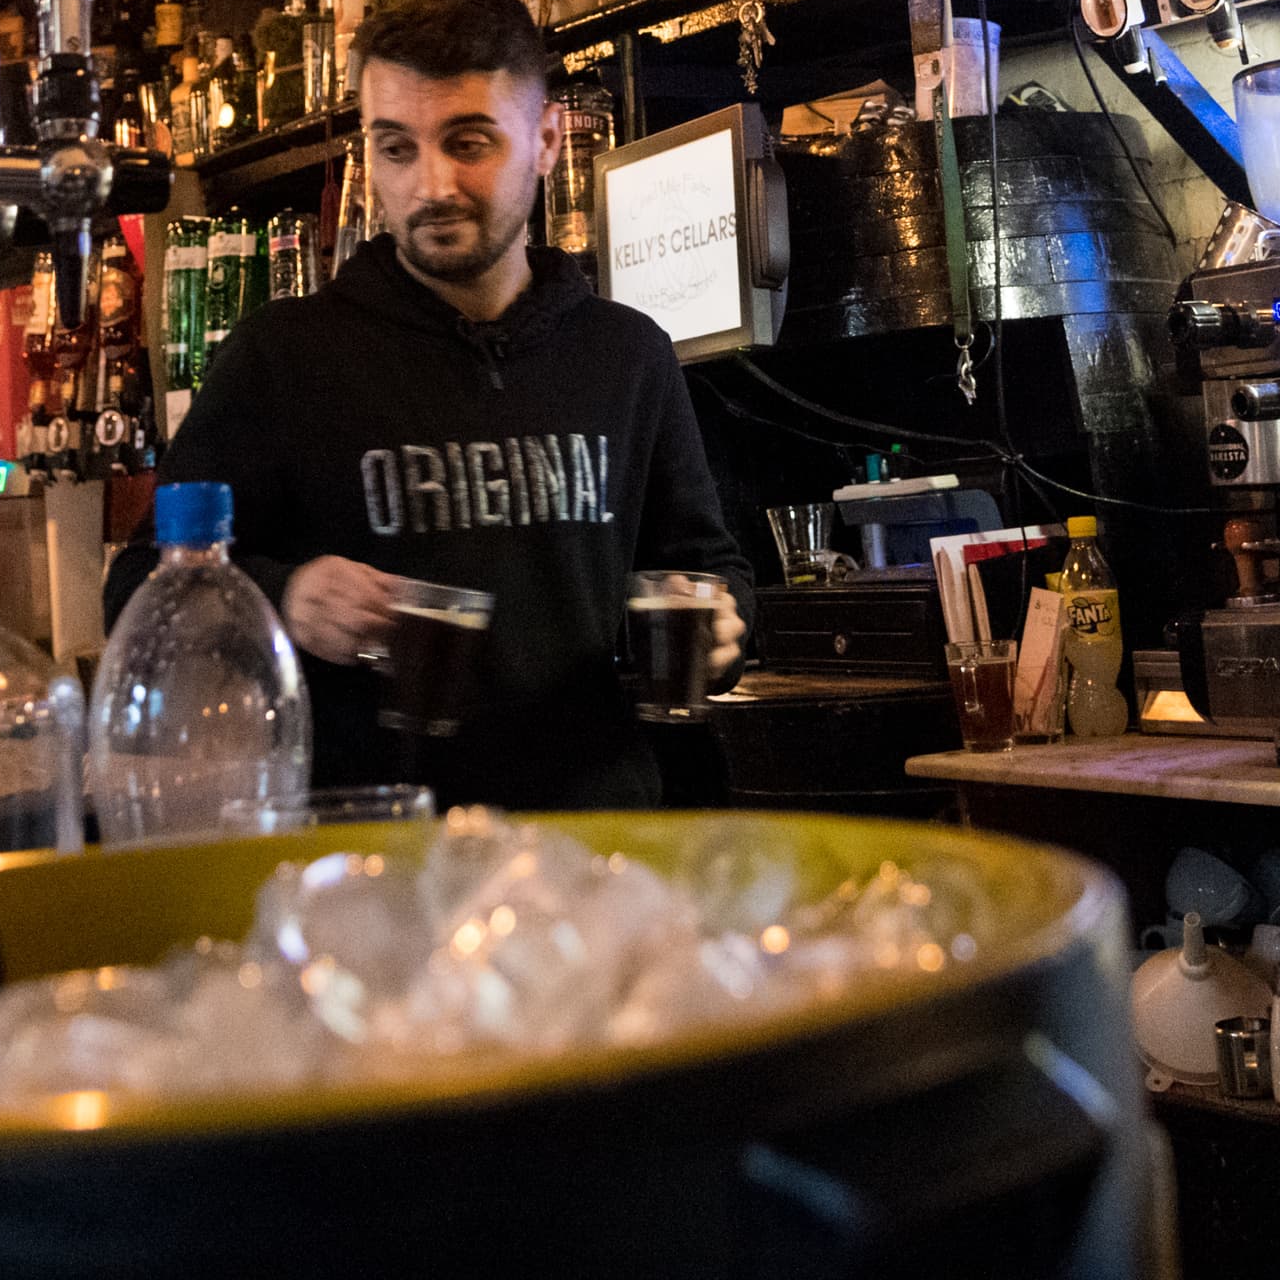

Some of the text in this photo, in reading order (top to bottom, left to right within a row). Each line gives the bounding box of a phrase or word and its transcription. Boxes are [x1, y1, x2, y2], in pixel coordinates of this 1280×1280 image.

[614, 212, 737, 271] KELLY'S CELLARS
[360, 433, 615, 536] ORIGINAL
[1069, 604, 1113, 625] FANTA
